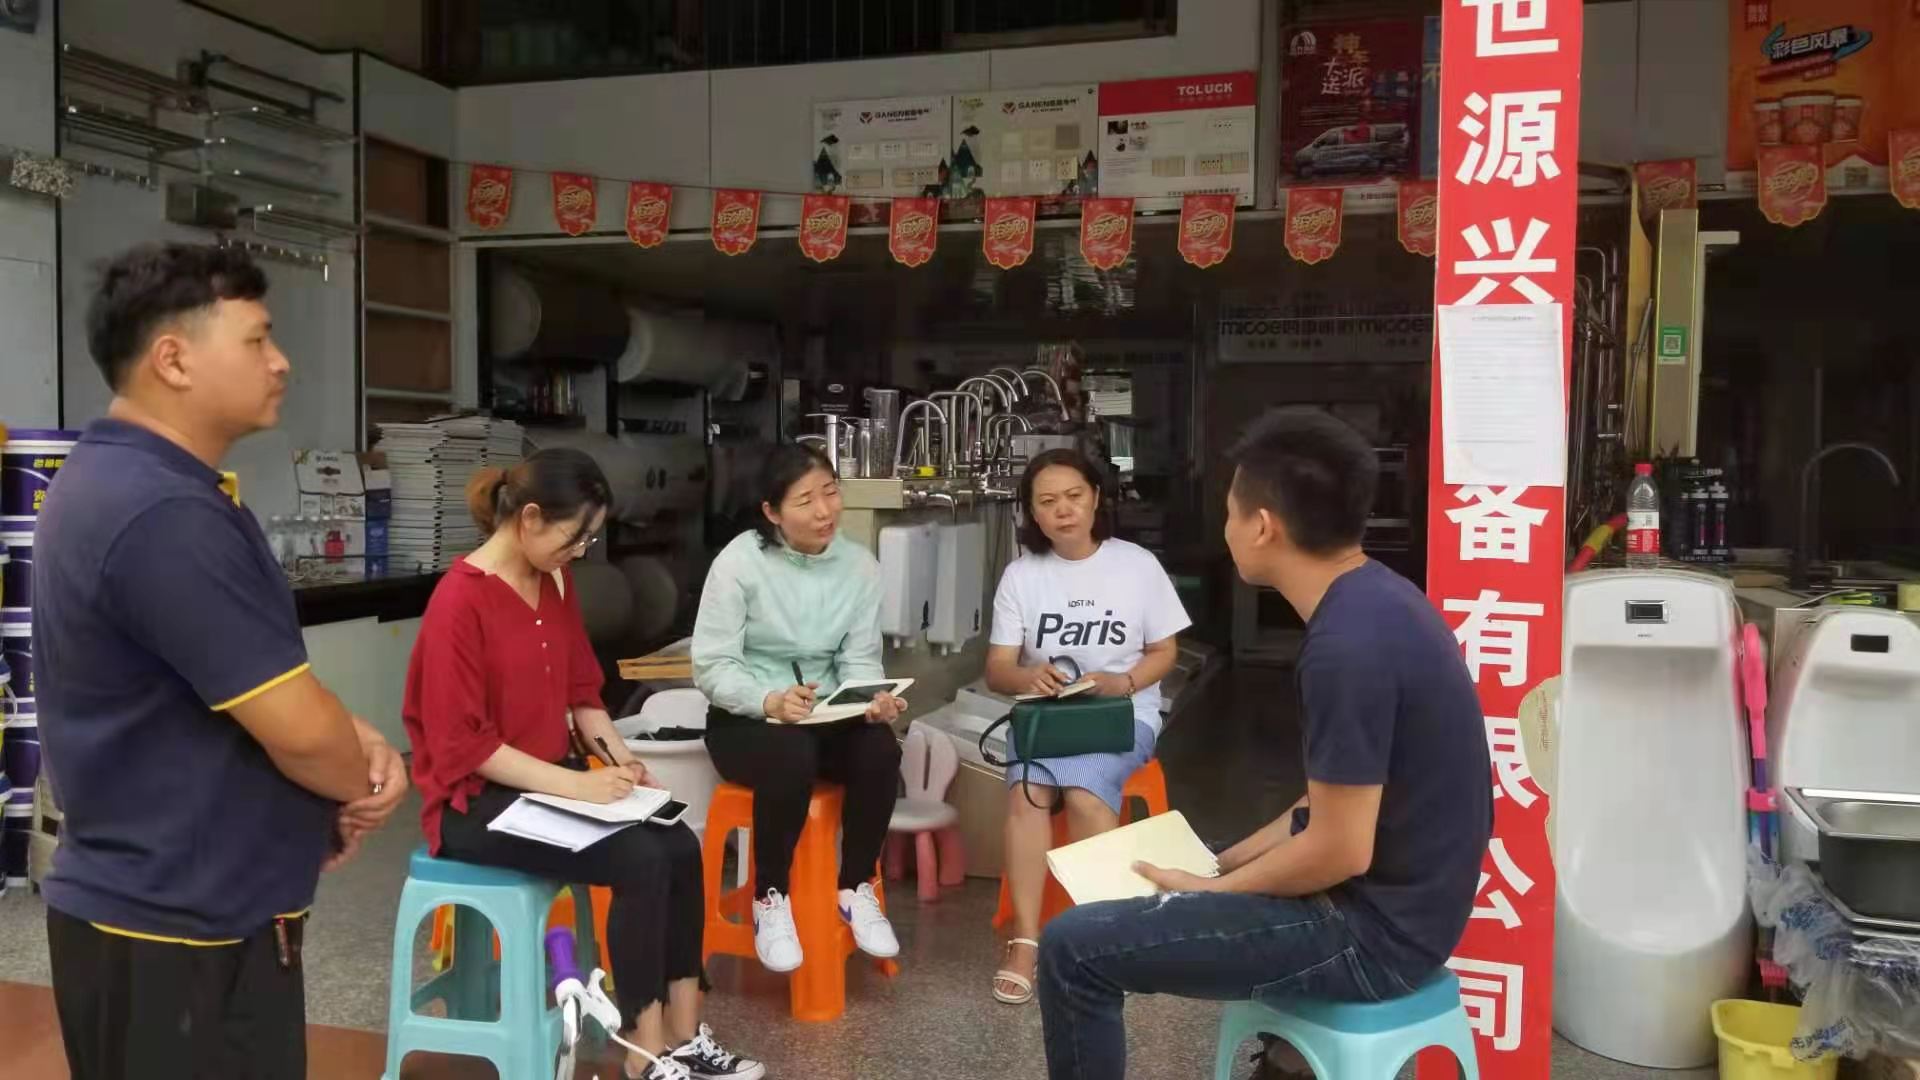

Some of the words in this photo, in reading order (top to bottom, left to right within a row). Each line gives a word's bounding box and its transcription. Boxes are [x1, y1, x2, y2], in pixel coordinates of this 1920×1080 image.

[1036, 610, 1127, 649] Paris
[1443, 0, 1562, 1051] 世源兴备有限公司
